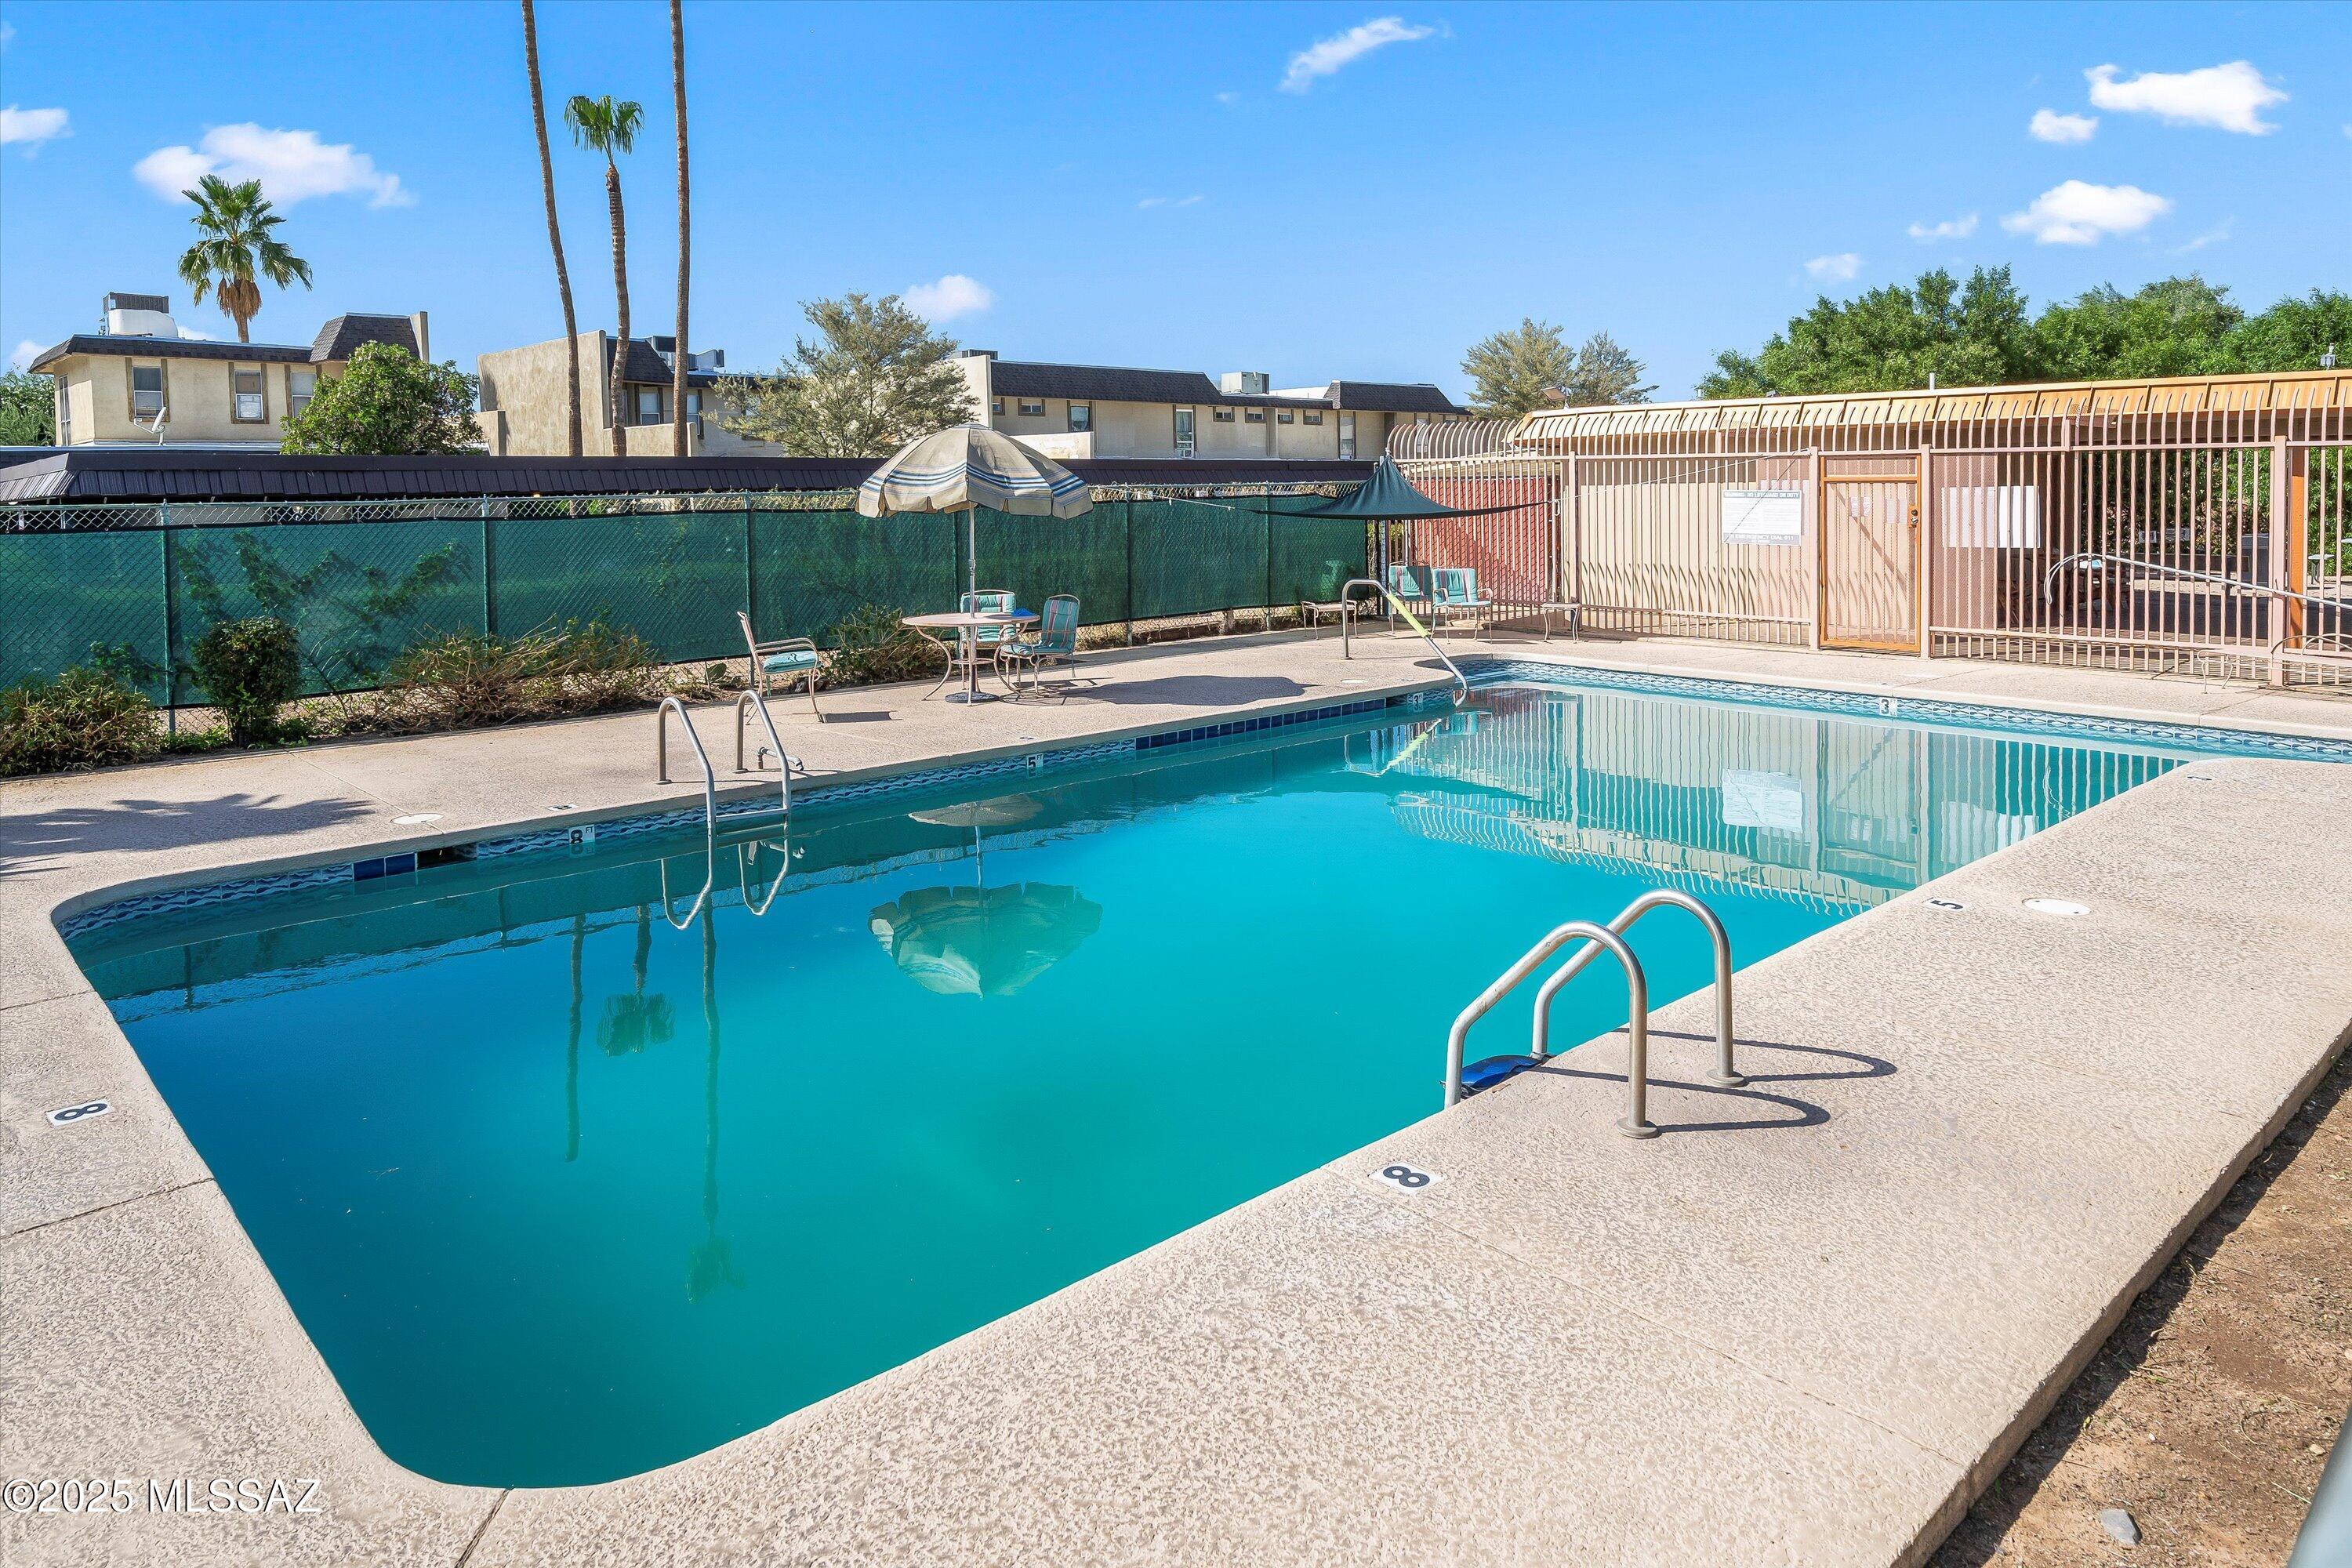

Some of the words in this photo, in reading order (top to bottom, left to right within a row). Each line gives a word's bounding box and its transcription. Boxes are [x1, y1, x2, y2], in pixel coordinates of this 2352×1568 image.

[1882, 699, 1889, 714] 3
[1028, 757, 1036, 768] 5
[570, 829, 583, 844] 8
[54, 1103, 108, 1120] 8
[1382, 1165, 1430, 1188] 8
